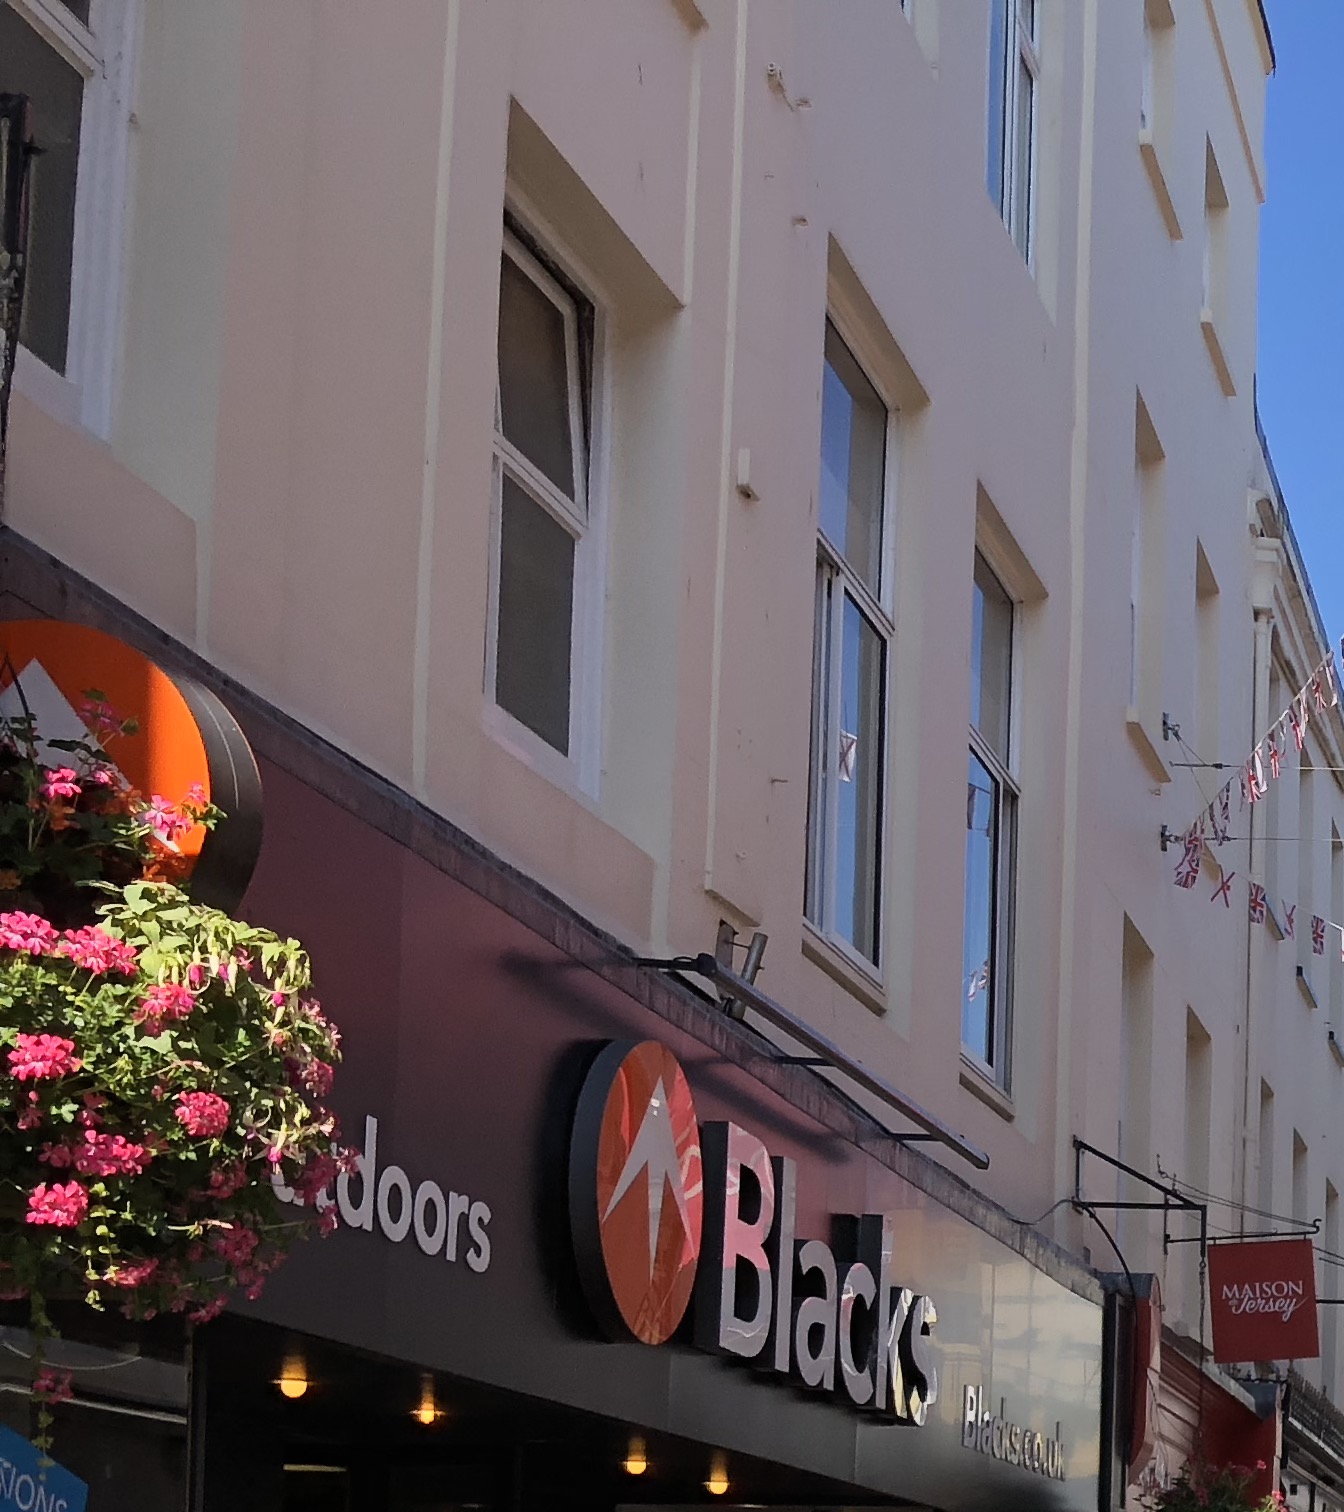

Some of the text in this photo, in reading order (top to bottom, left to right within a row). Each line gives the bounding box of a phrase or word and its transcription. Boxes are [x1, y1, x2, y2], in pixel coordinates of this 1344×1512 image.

[271, 1115, 492, 1274] doors
[714, 1120, 938, 1428] Blacks
[1221, 1280, 1304, 1300] MAISON
[1231, 1294, 1298, 1323] Jersey
[961, 1384, 1065, 1482] Blacks.co.uk
